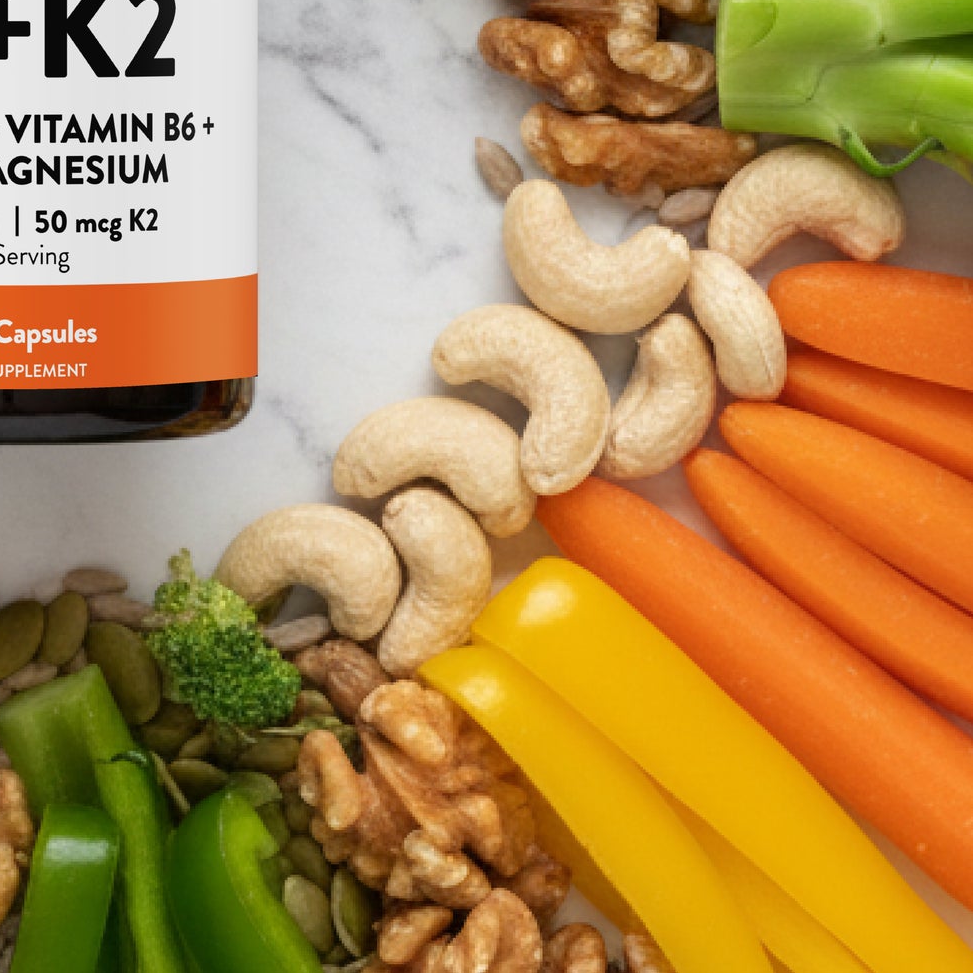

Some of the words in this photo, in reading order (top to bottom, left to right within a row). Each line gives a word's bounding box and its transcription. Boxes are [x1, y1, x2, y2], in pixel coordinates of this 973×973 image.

[4, 112, 153, 144] VITAMIN
[164, 111, 196, 142] B6
[202, 116, 215, 135] +
[35, 209, 68, 234] 50
[75, 217, 123, 243] mcg
[129, 208, 159, 232] K2
